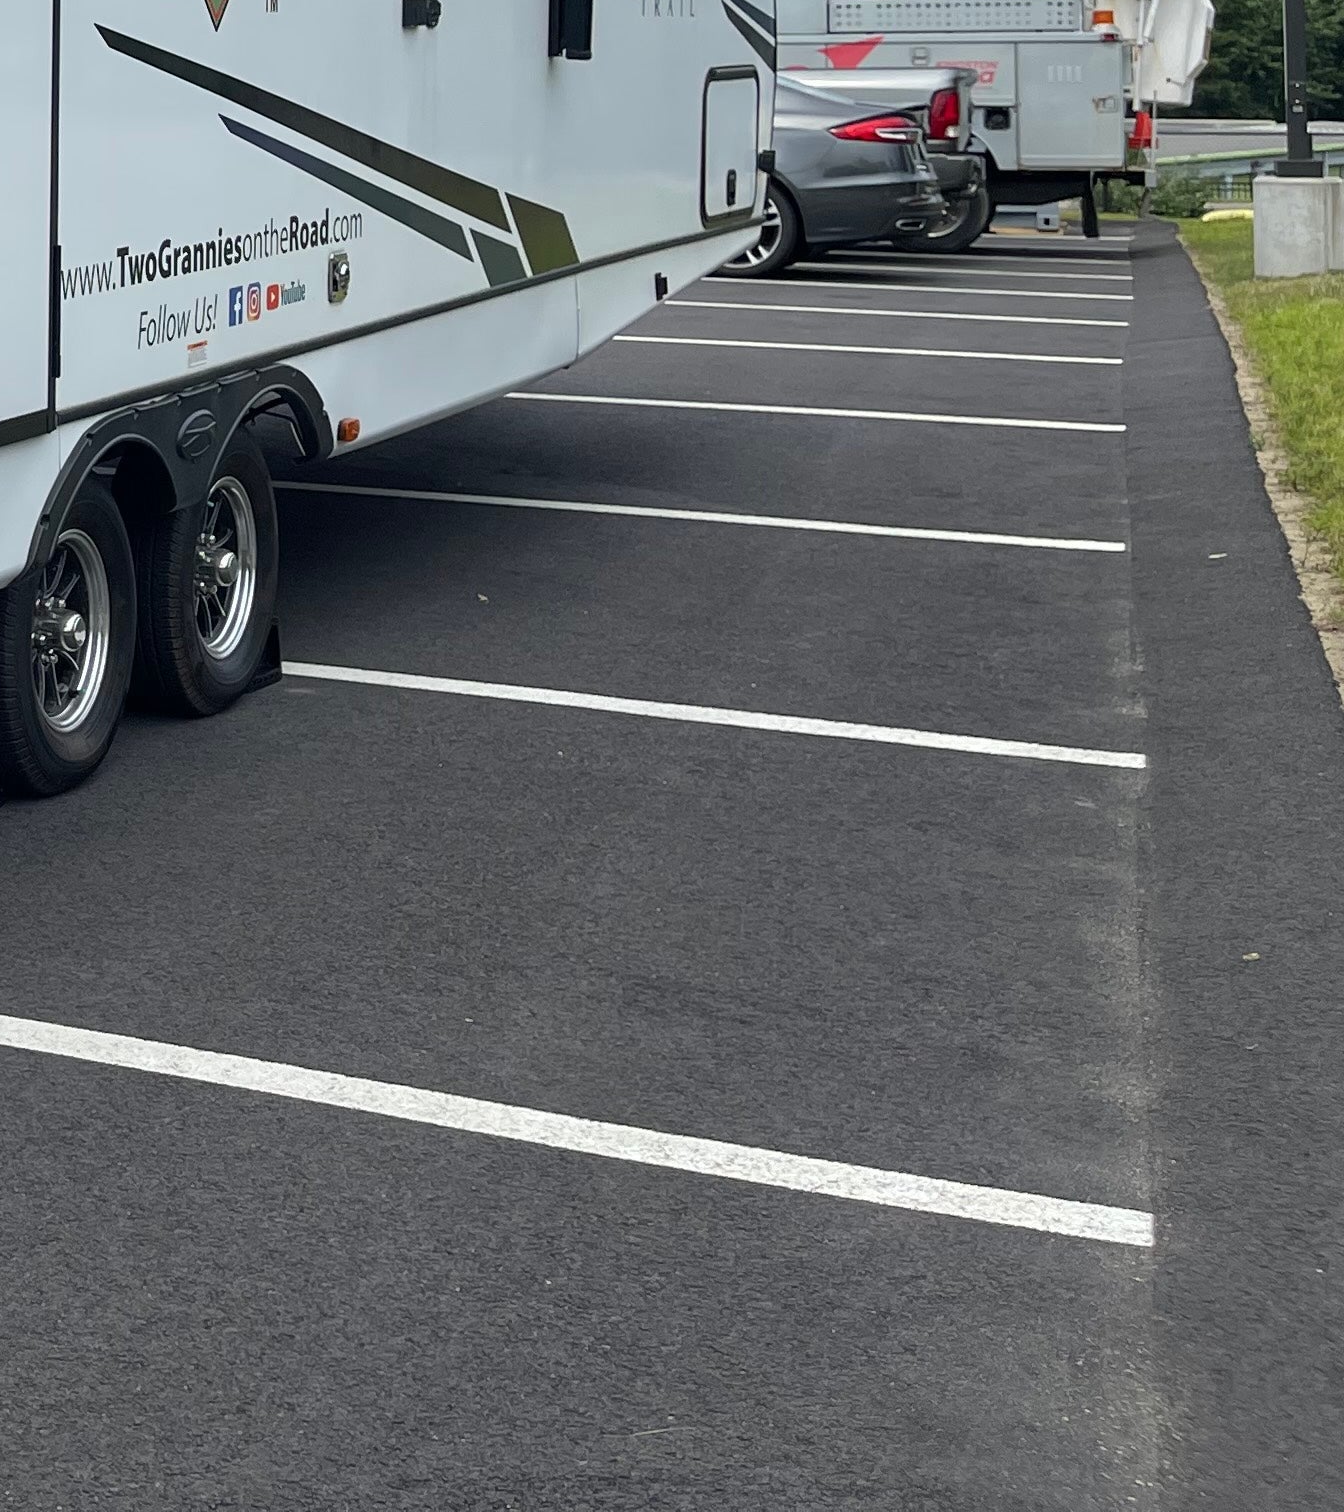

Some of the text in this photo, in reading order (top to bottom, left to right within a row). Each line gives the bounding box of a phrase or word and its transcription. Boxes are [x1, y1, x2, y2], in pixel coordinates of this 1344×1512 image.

[60, 207, 363, 301] www.TwoGranniesontheRoad.com
[279, 279, 306, 306] YouTube
[137, 293, 219, 350] Follow Us!
